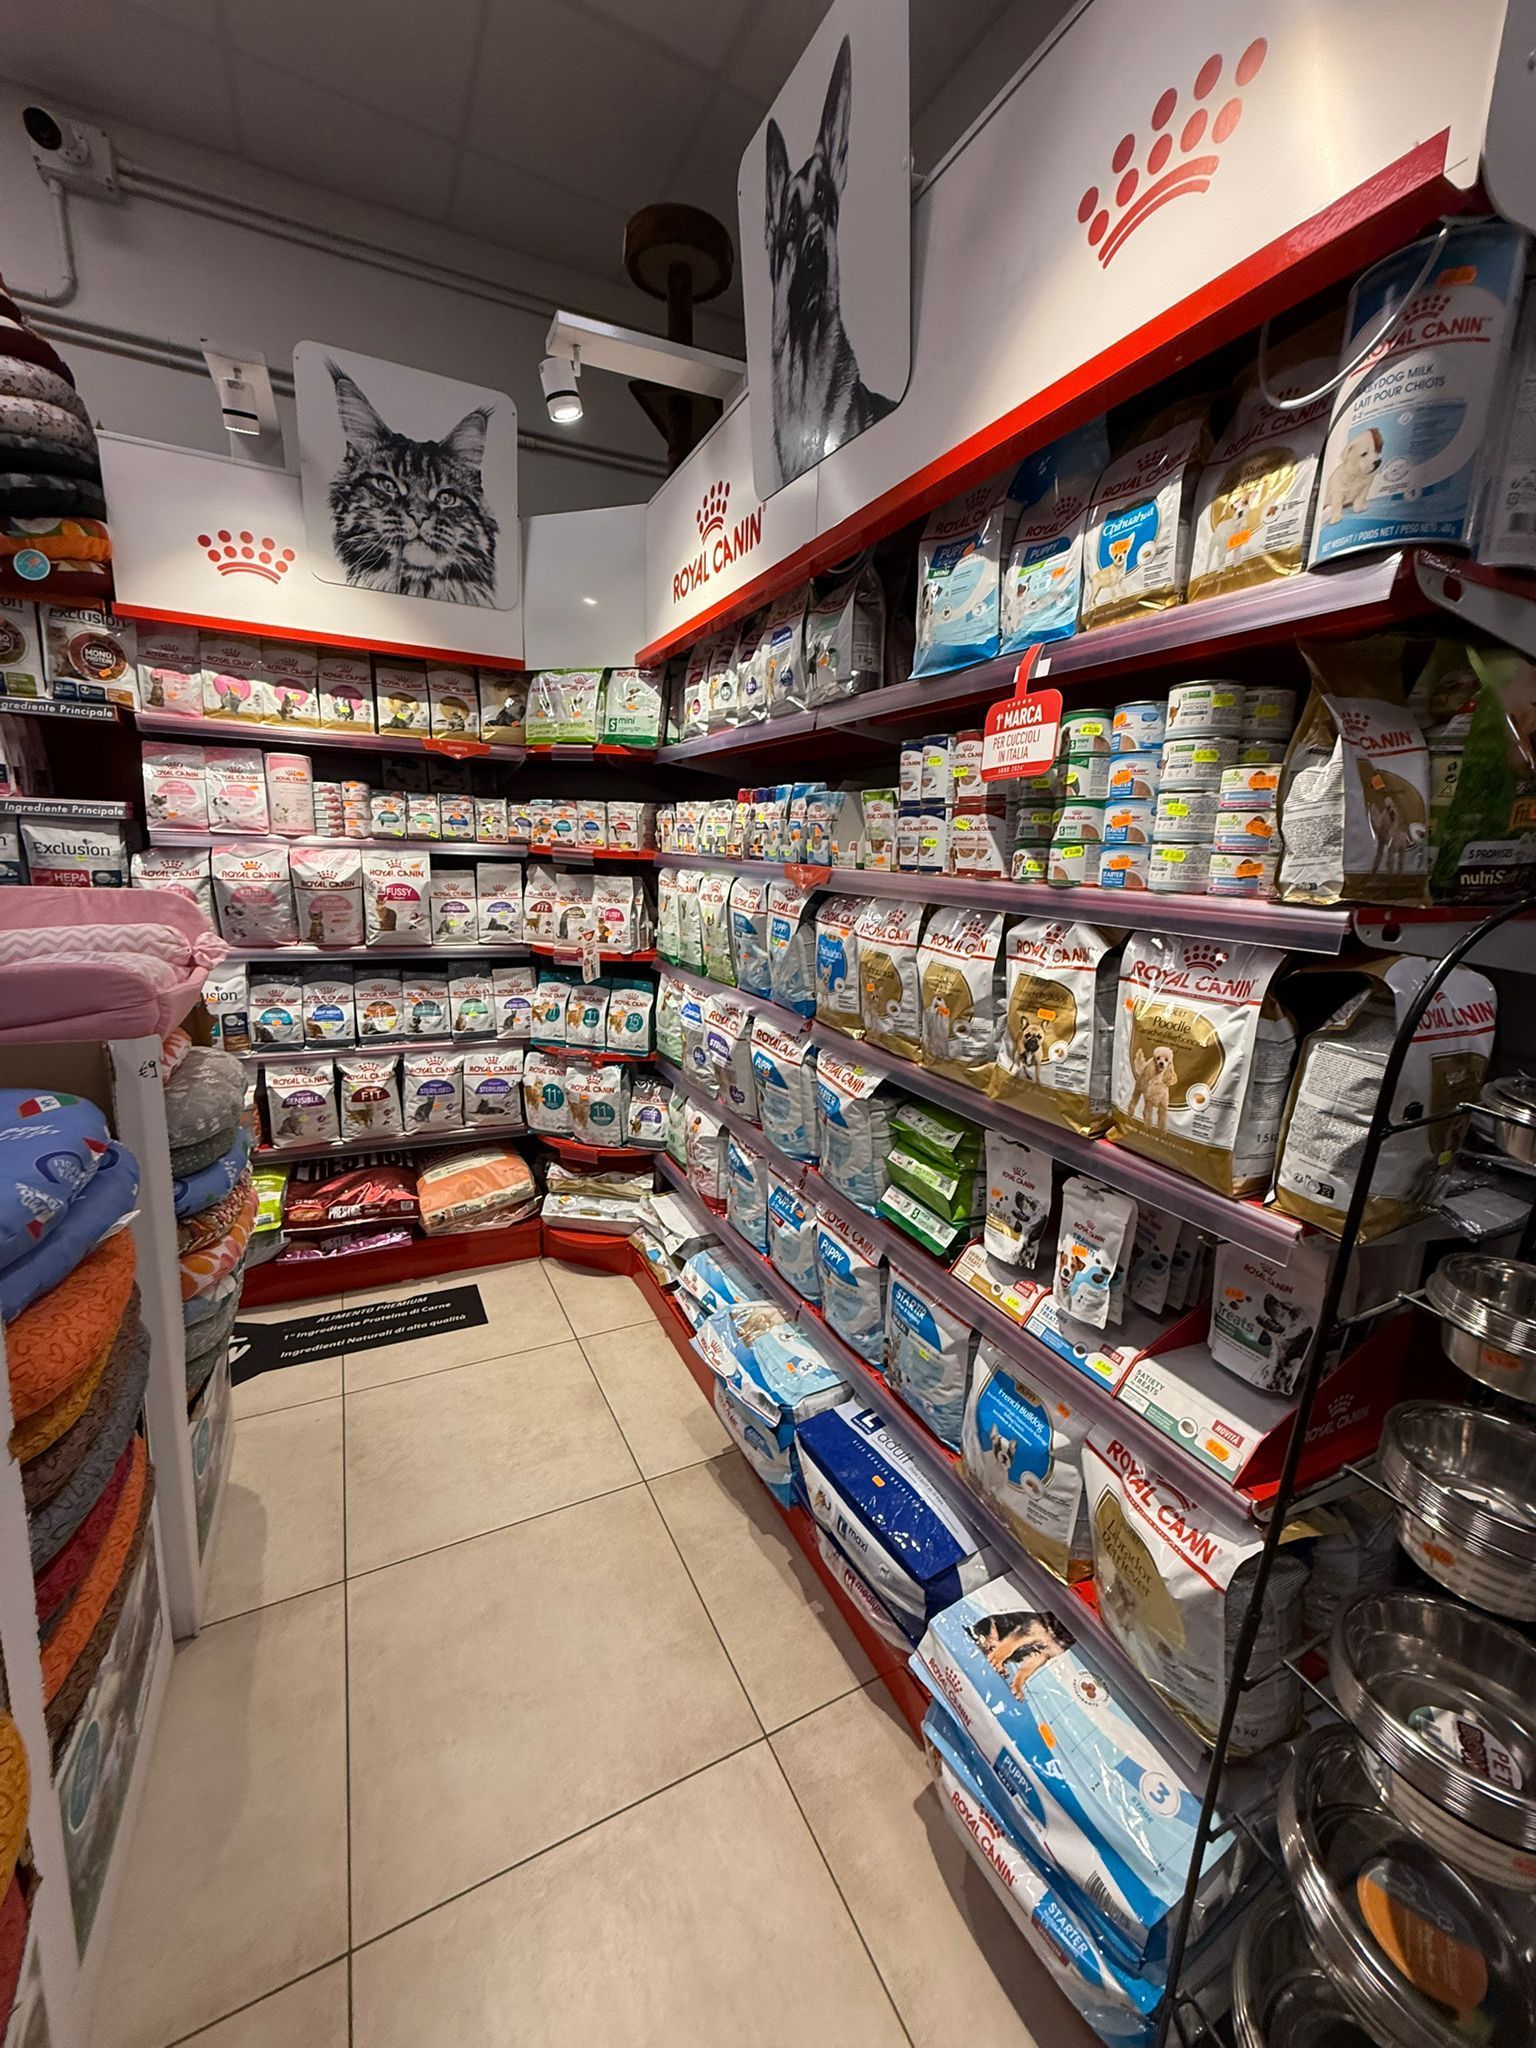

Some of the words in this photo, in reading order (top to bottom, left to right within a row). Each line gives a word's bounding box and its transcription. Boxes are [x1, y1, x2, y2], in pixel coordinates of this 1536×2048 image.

[1368, 330, 1415, 361] OYAL
[1422, 317, 1484, 339] CANIN
[1407, 364, 1434, 380] MILK
[1353, 397, 1372, 411] LAIT
[1374, 387, 1402, 403] POUR
[1405, 376, 1446, 392] CHIOTS
[1102, 478, 1143, 499] ROYAL
[935, 515, 970, 534] ROYAL
[1026, 524, 1058, 537] ROYAL
[1103, 506, 1155, 538] Chihuahua
[673, 551, 710, 604] ROYAL
[713, 506, 762, 573] CANIN
[85, 648, 112, 659] MONO
[60, 704, 113, 718] Principale
[1004, 704, 1043, 729] MARCA
[992, 736, 1006, 750] PER
[1006, 729, 1041, 747] CUCCIOLI
[1359, 731, 1412, 750] CANIN
[998, 750, 1005, 763] IN
[1007, 746, 1029, 762] ITALIA
[4, 802, 68, 813] Ingrediente
[71, 804, 124, 816] Principale
[32, 841, 110, 856] Exclusion
[54, 872, 88, 882] HEPA
[141, 869, 171, 877] ROYAL
[221, 870, 250, 878] ROYAL
[252, 871, 281, 879] CANIN
[301, 880, 328, 888] ROYAL
[386, 887, 412, 896] FUSSY
[1016, 939, 1050, 960] ROYAL
[1132, 960, 1190, 989] ROYAL
[1194, 975, 1256, 998] CANIN
[200, 991, 238, 1002] usion
[1152, 1016, 1192, 1034] Poodle
[138, 1060, 158, 1079] €9
[409, 1066, 434, 1074] ROYAL
[361, 1091, 382, 1101] FIT
[570, 1084, 593, 1093] ROYAL
[593, 1086, 615, 1094] CANIN
[285, 1096, 319, 1105] SENSIBLE
[1016, 1176, 1036, 1190] CANIN
[823, 1208, 851, 1238] ROYAL
[819, 1238, 845, 1266] PUPPY
[316, 1307, 375, 1324] ALIMENTO
[375, 1296, 428, 1312] PREMIUM
[895, 1288, 928, 1320] STARTER
[296, 1320, 361, 1338] Ingrediente
[362, 1310, 408, 1325] Proteina
[408, 1308, 419, 1317] di
[420, 1302, 452, 1313] Carne
[1215, 1301, 1255, 1333] Treats
[279, 1339, 345, 1358] Ingredienti
[346, 1328, 393, 1344] Naturali
[394, 1326, 405, 1335] di
[406, 1322, 428, 1332] alta
[429, 1313, 467, 1328] qualità
[1133, 1376, 1160, 1396] TREATS
[1136, 1369, 1165, 1391] SATIETY
[998, 1387, 1021, 1410] French
[1019, 1406, 1045, 1434] Bulldog
[1215, 1424, 1241, 1445] NOVITÀ
[877, 1431, 915, 1464] adult
[1106, 1439, 1157, 1508] ROYAL
[1157, 1504, 1218, 1565] CANN
[847, 1525, 869, 1553] maxi
[928, 1657, 951, 1692] ROYAL
[1002, 1755, 1033, 1795] PUPPY
[1149, 1771, 1171, 1805] 3
[1130, 1795, 1154, 1825] STAGE
[951, 1791, 981, 1839] ROYAL
[980, 1836, 1015, 1888] CANIN
[1047, 1901, 1089, 1955] STARTER
